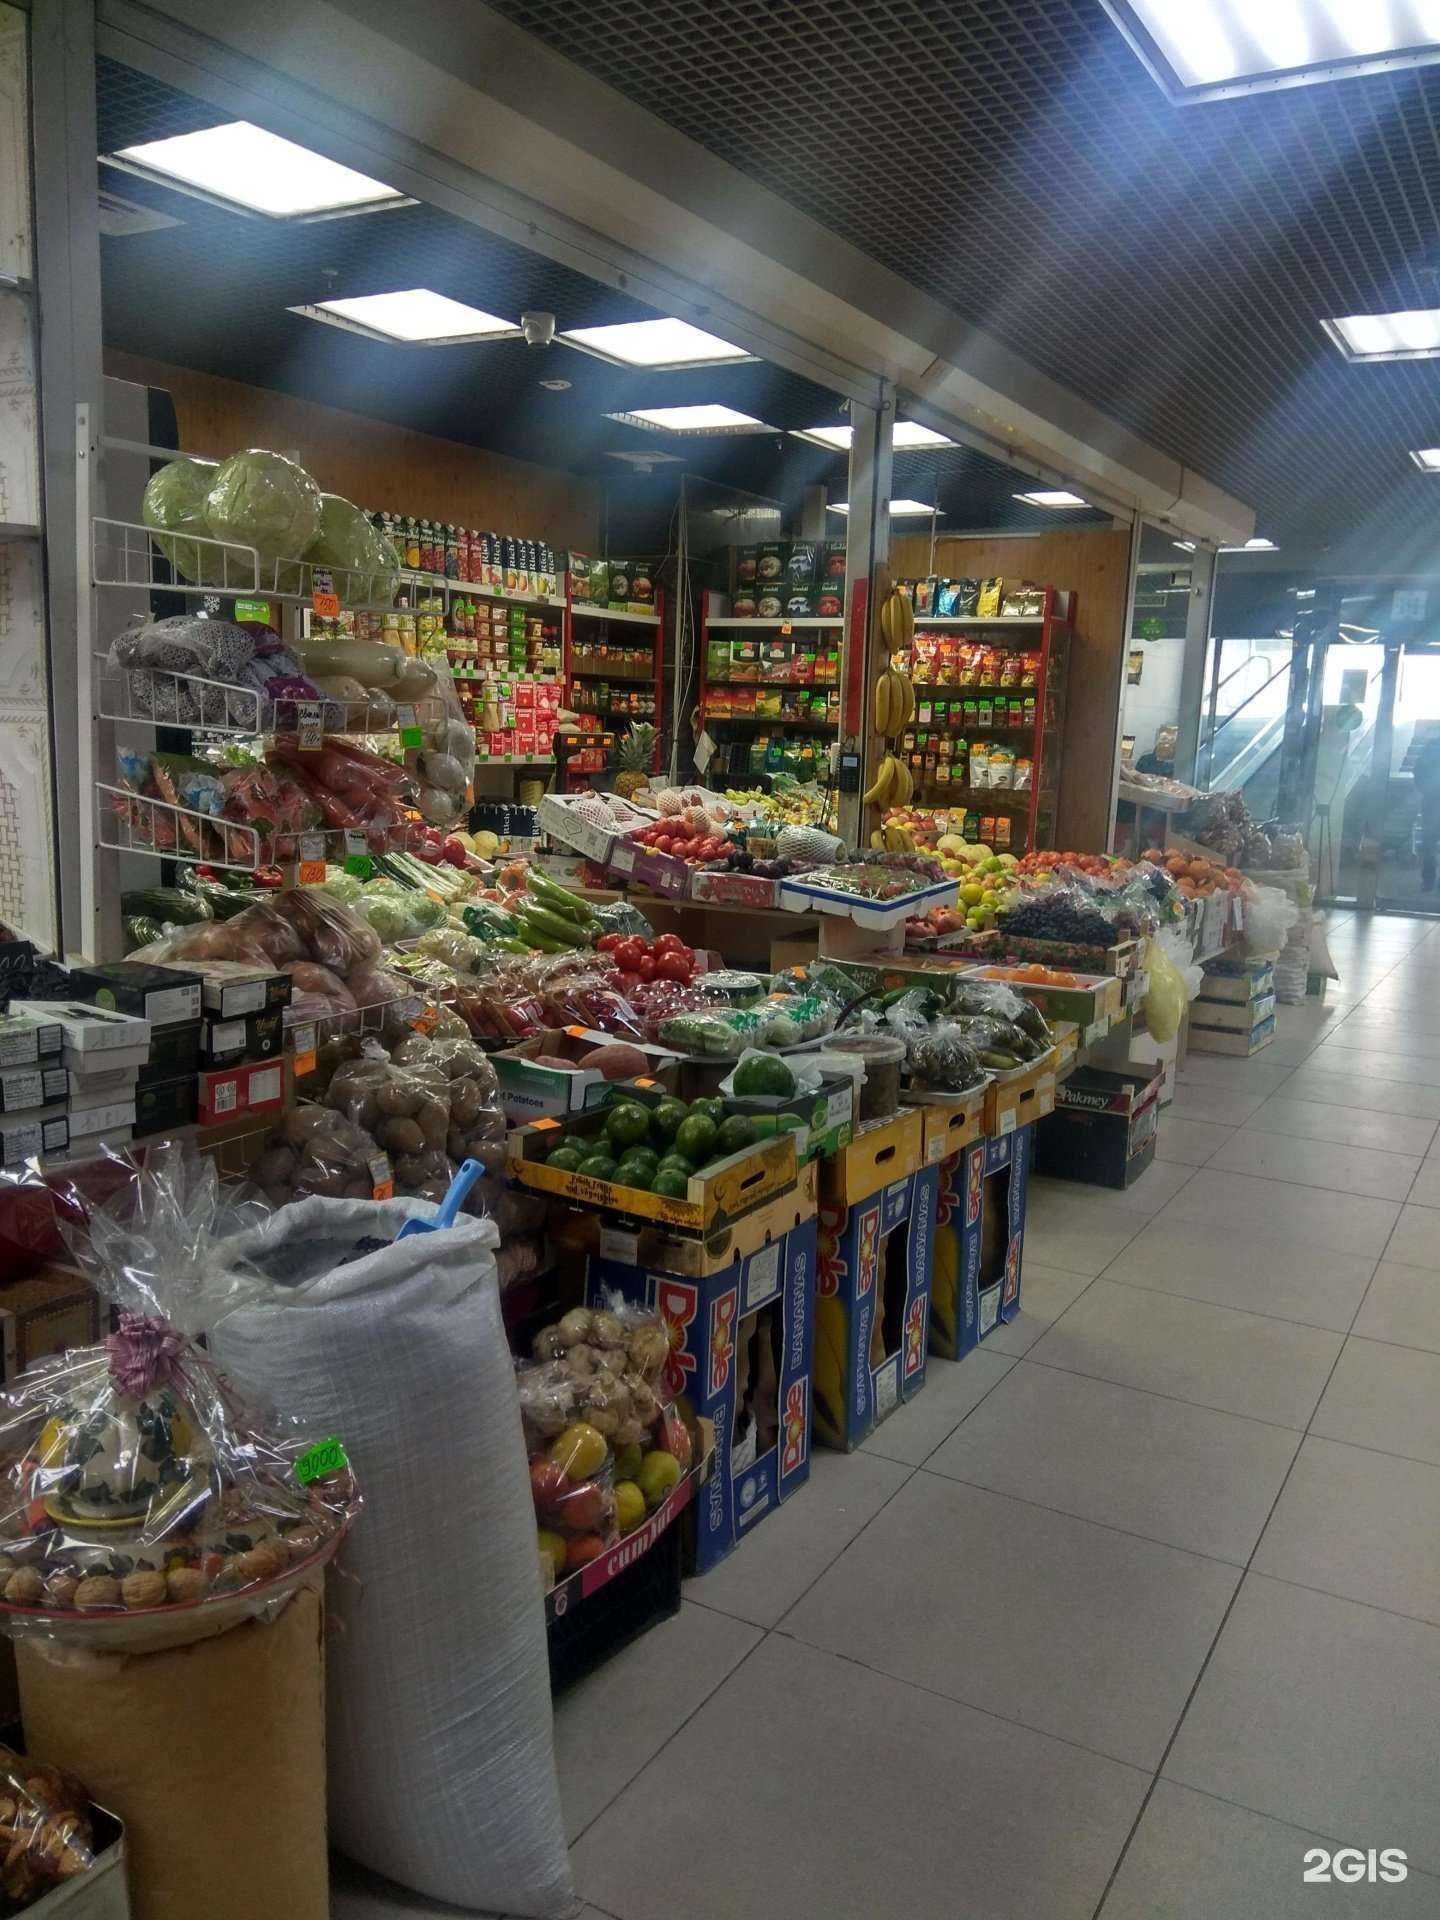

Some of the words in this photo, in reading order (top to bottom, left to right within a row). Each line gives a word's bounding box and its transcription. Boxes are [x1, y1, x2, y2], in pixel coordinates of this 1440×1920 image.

[916, 1183, 931, 1287] BANANAS
[968, 1148, 984, 1221] Dole
[859, 1207, 879, 1294] Dole
[658, 1280, 699, 1397] Dole
[712, 1288, 737, 1391] Dole
[791, 1252, 807, 1370] BANANAS
[857, 1304, 871, 1418] BANANAS
[905, 1297, 926, 1375] Dole
[710, 1403, 727, 1532] BANANAS
[783, 1382, 805, 1472] Dole
